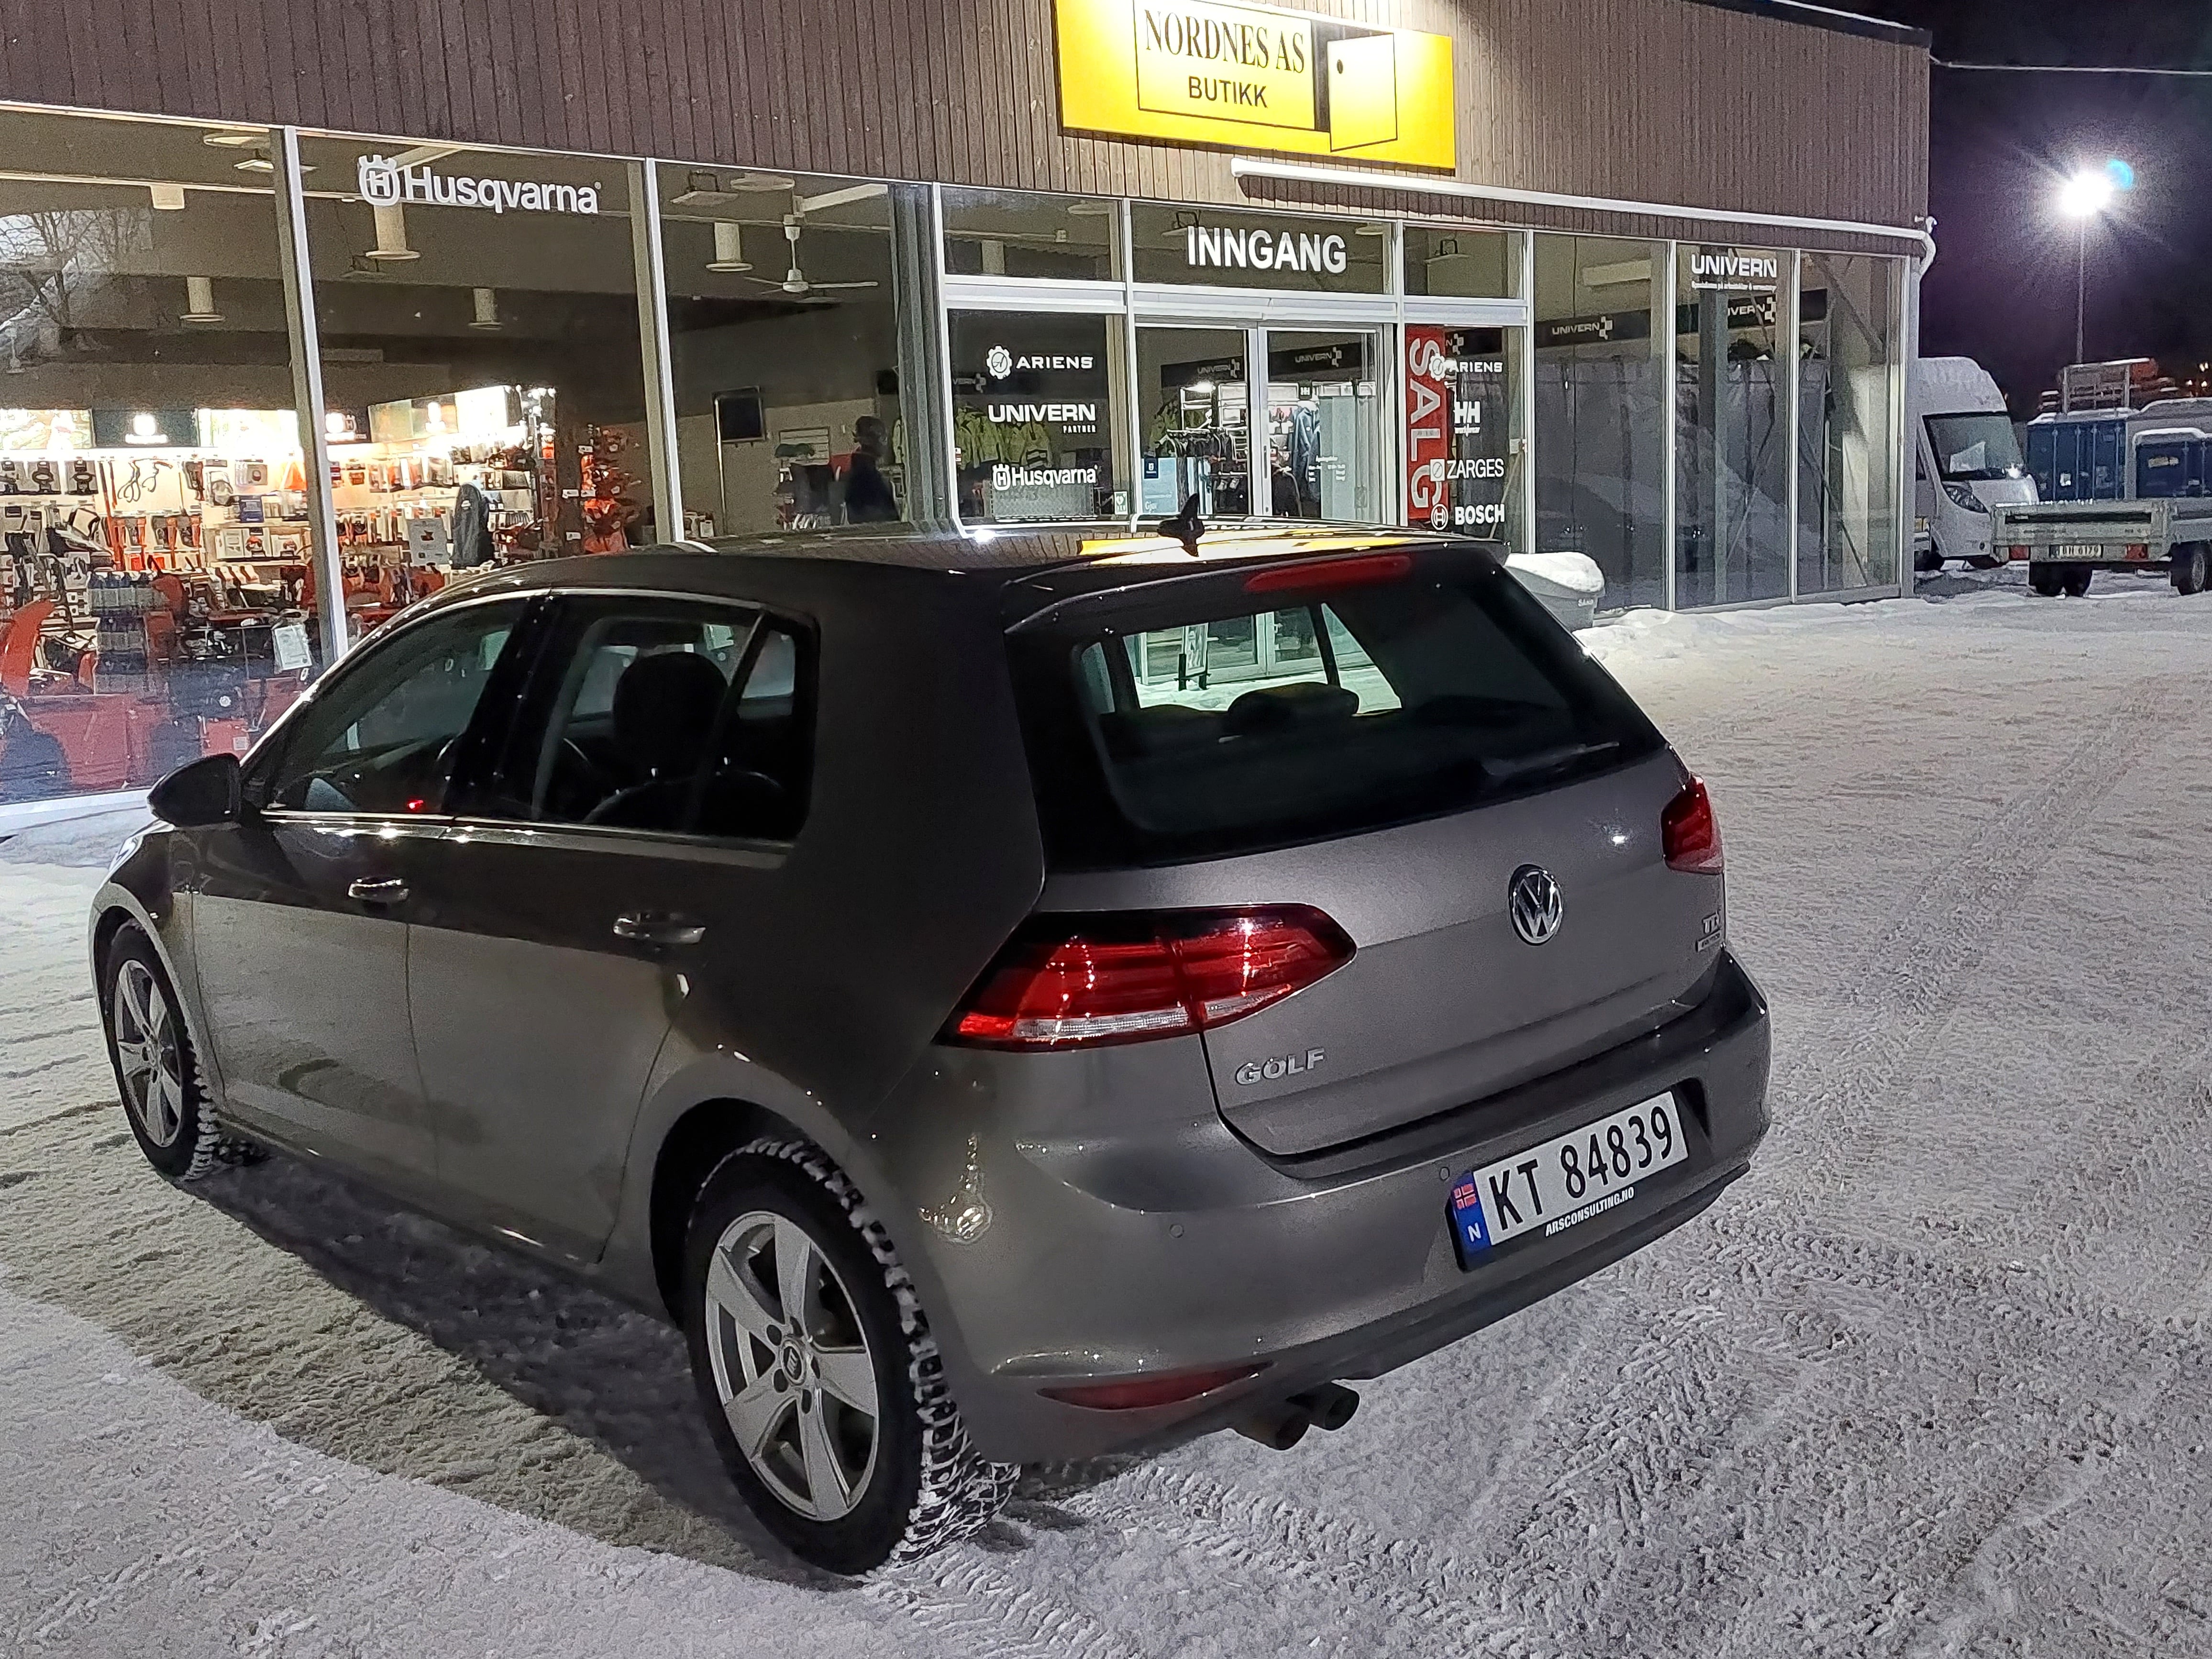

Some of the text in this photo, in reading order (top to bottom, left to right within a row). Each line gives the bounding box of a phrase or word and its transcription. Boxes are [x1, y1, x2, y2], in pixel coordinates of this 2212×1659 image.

[1145, 9, 1305, 74] NORDNES AS
[1189, 76, 1268, 109] BUTIKK
[404, 166, 598, 214] Husqvarna
[1188, 225, 1347, 273] INNGANG
[1692, 254, 1777, 278] UNIVERN
[1727, 303, 1765, 316] IVERN
[1552, 322, 1600, 335] UNIVERN
[1016, 355, 1094, 369] ARIENS
[1449, 361, 1503, 373] ARIENS
[988, 404, 1096, 422] UNIVERN
[1409, 338, 1443, 508] SALG
[1062, 424, 1096, 434] PARTNER
[1012, 466, 1096, 488] Husqvarna
[1447, 458, 1504, 479] ZARGES
[1455, 504, 1505, 525] BOSCH
[1236, 1048, 1325, 1085] GOLF
[1489, 1106, 1672, 1231] KT 84839
[1546, 1186, 1635, 1237] ARSCONSULTING.NO
[1468, 1223, 1482, 1242] N
